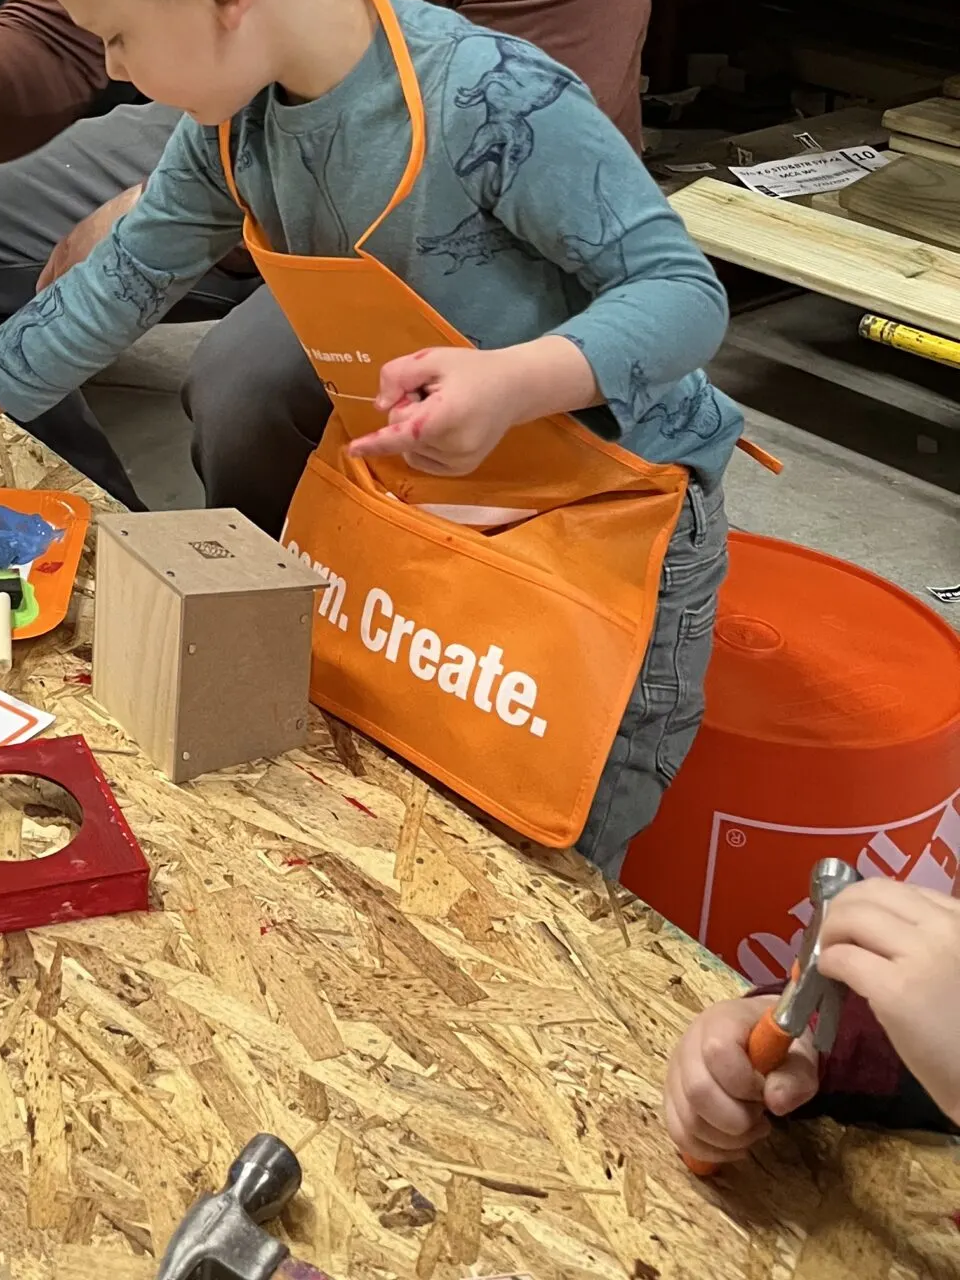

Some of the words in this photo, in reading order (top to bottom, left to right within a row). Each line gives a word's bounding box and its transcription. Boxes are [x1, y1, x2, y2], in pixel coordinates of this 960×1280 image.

[852, 150, 876, 161] 10
[311, 347, 353, 363] Name
[356, 350, 372, 363] Is
[360, 586, 548, 738] Create.
